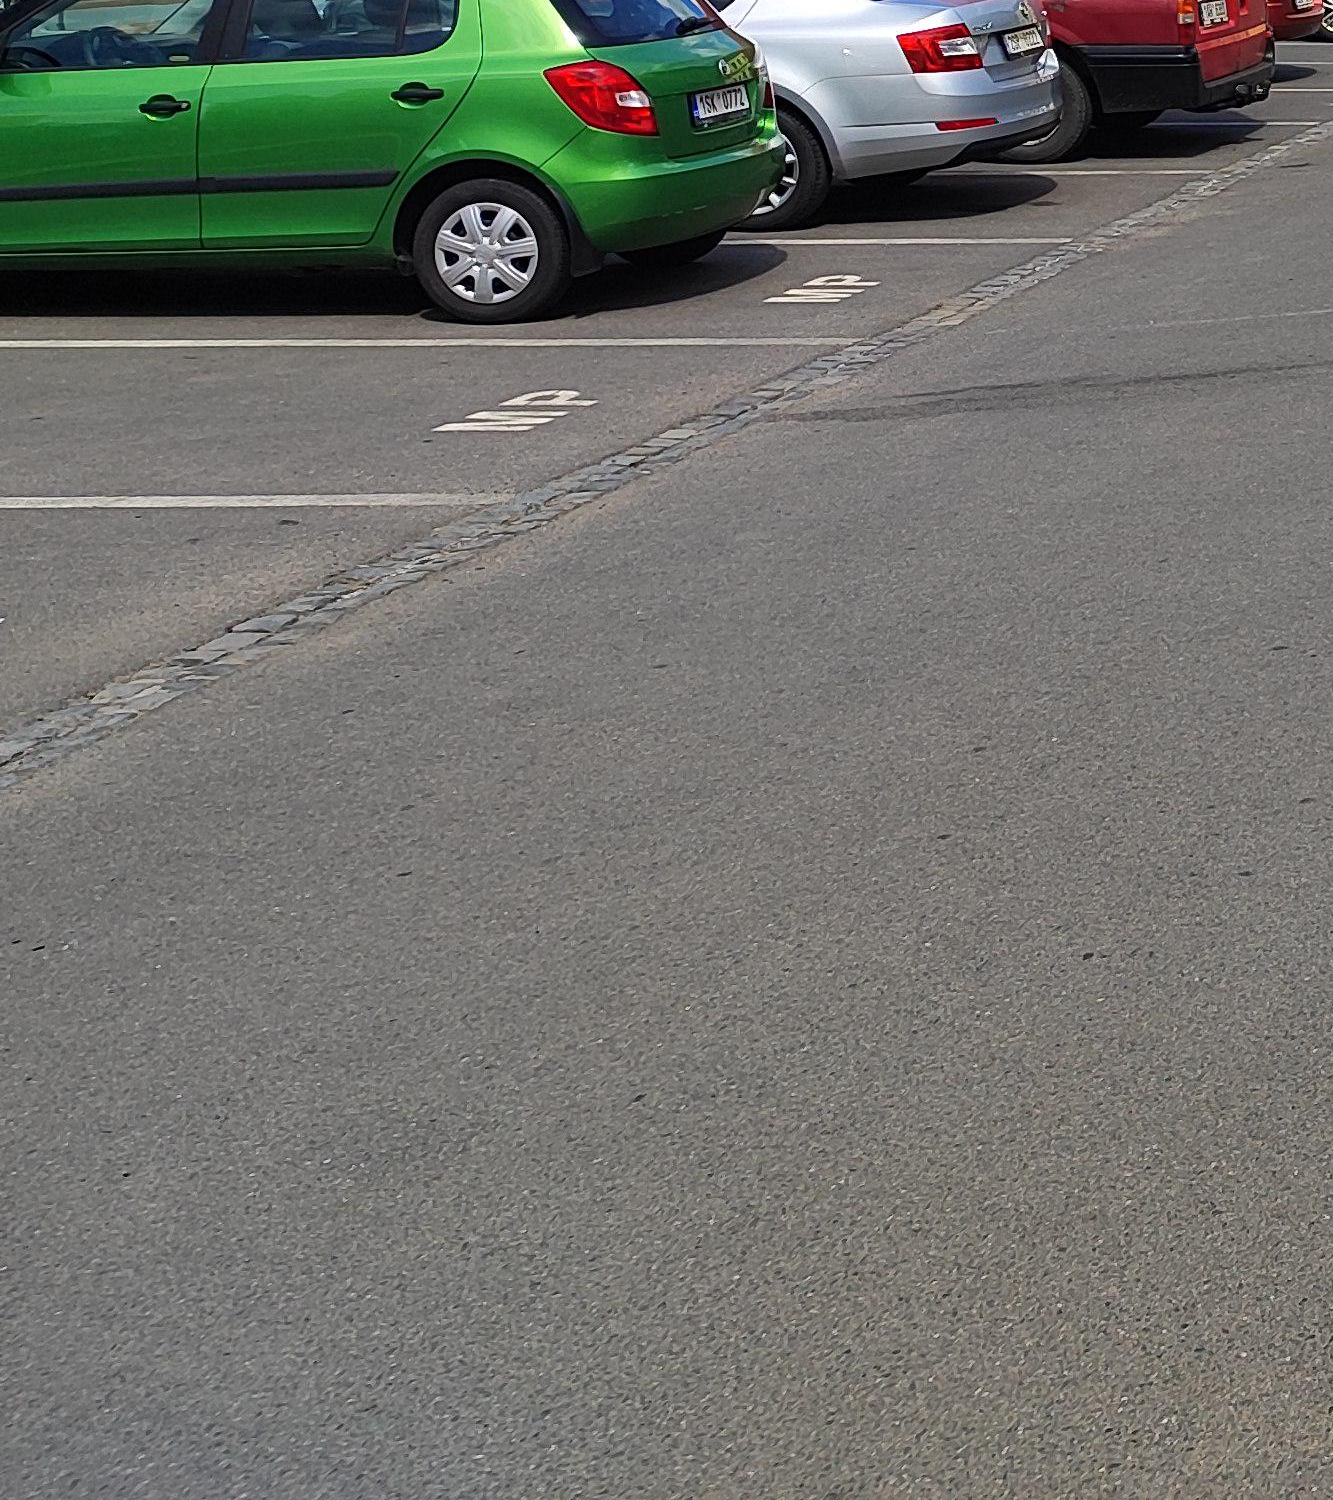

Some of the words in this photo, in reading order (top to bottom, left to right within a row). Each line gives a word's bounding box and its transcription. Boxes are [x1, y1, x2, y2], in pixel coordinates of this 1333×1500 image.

[700, 94, 718, 115] 1SK
[721, 88, 745, 110] 0772
[431, 390, 599, 432] MP
